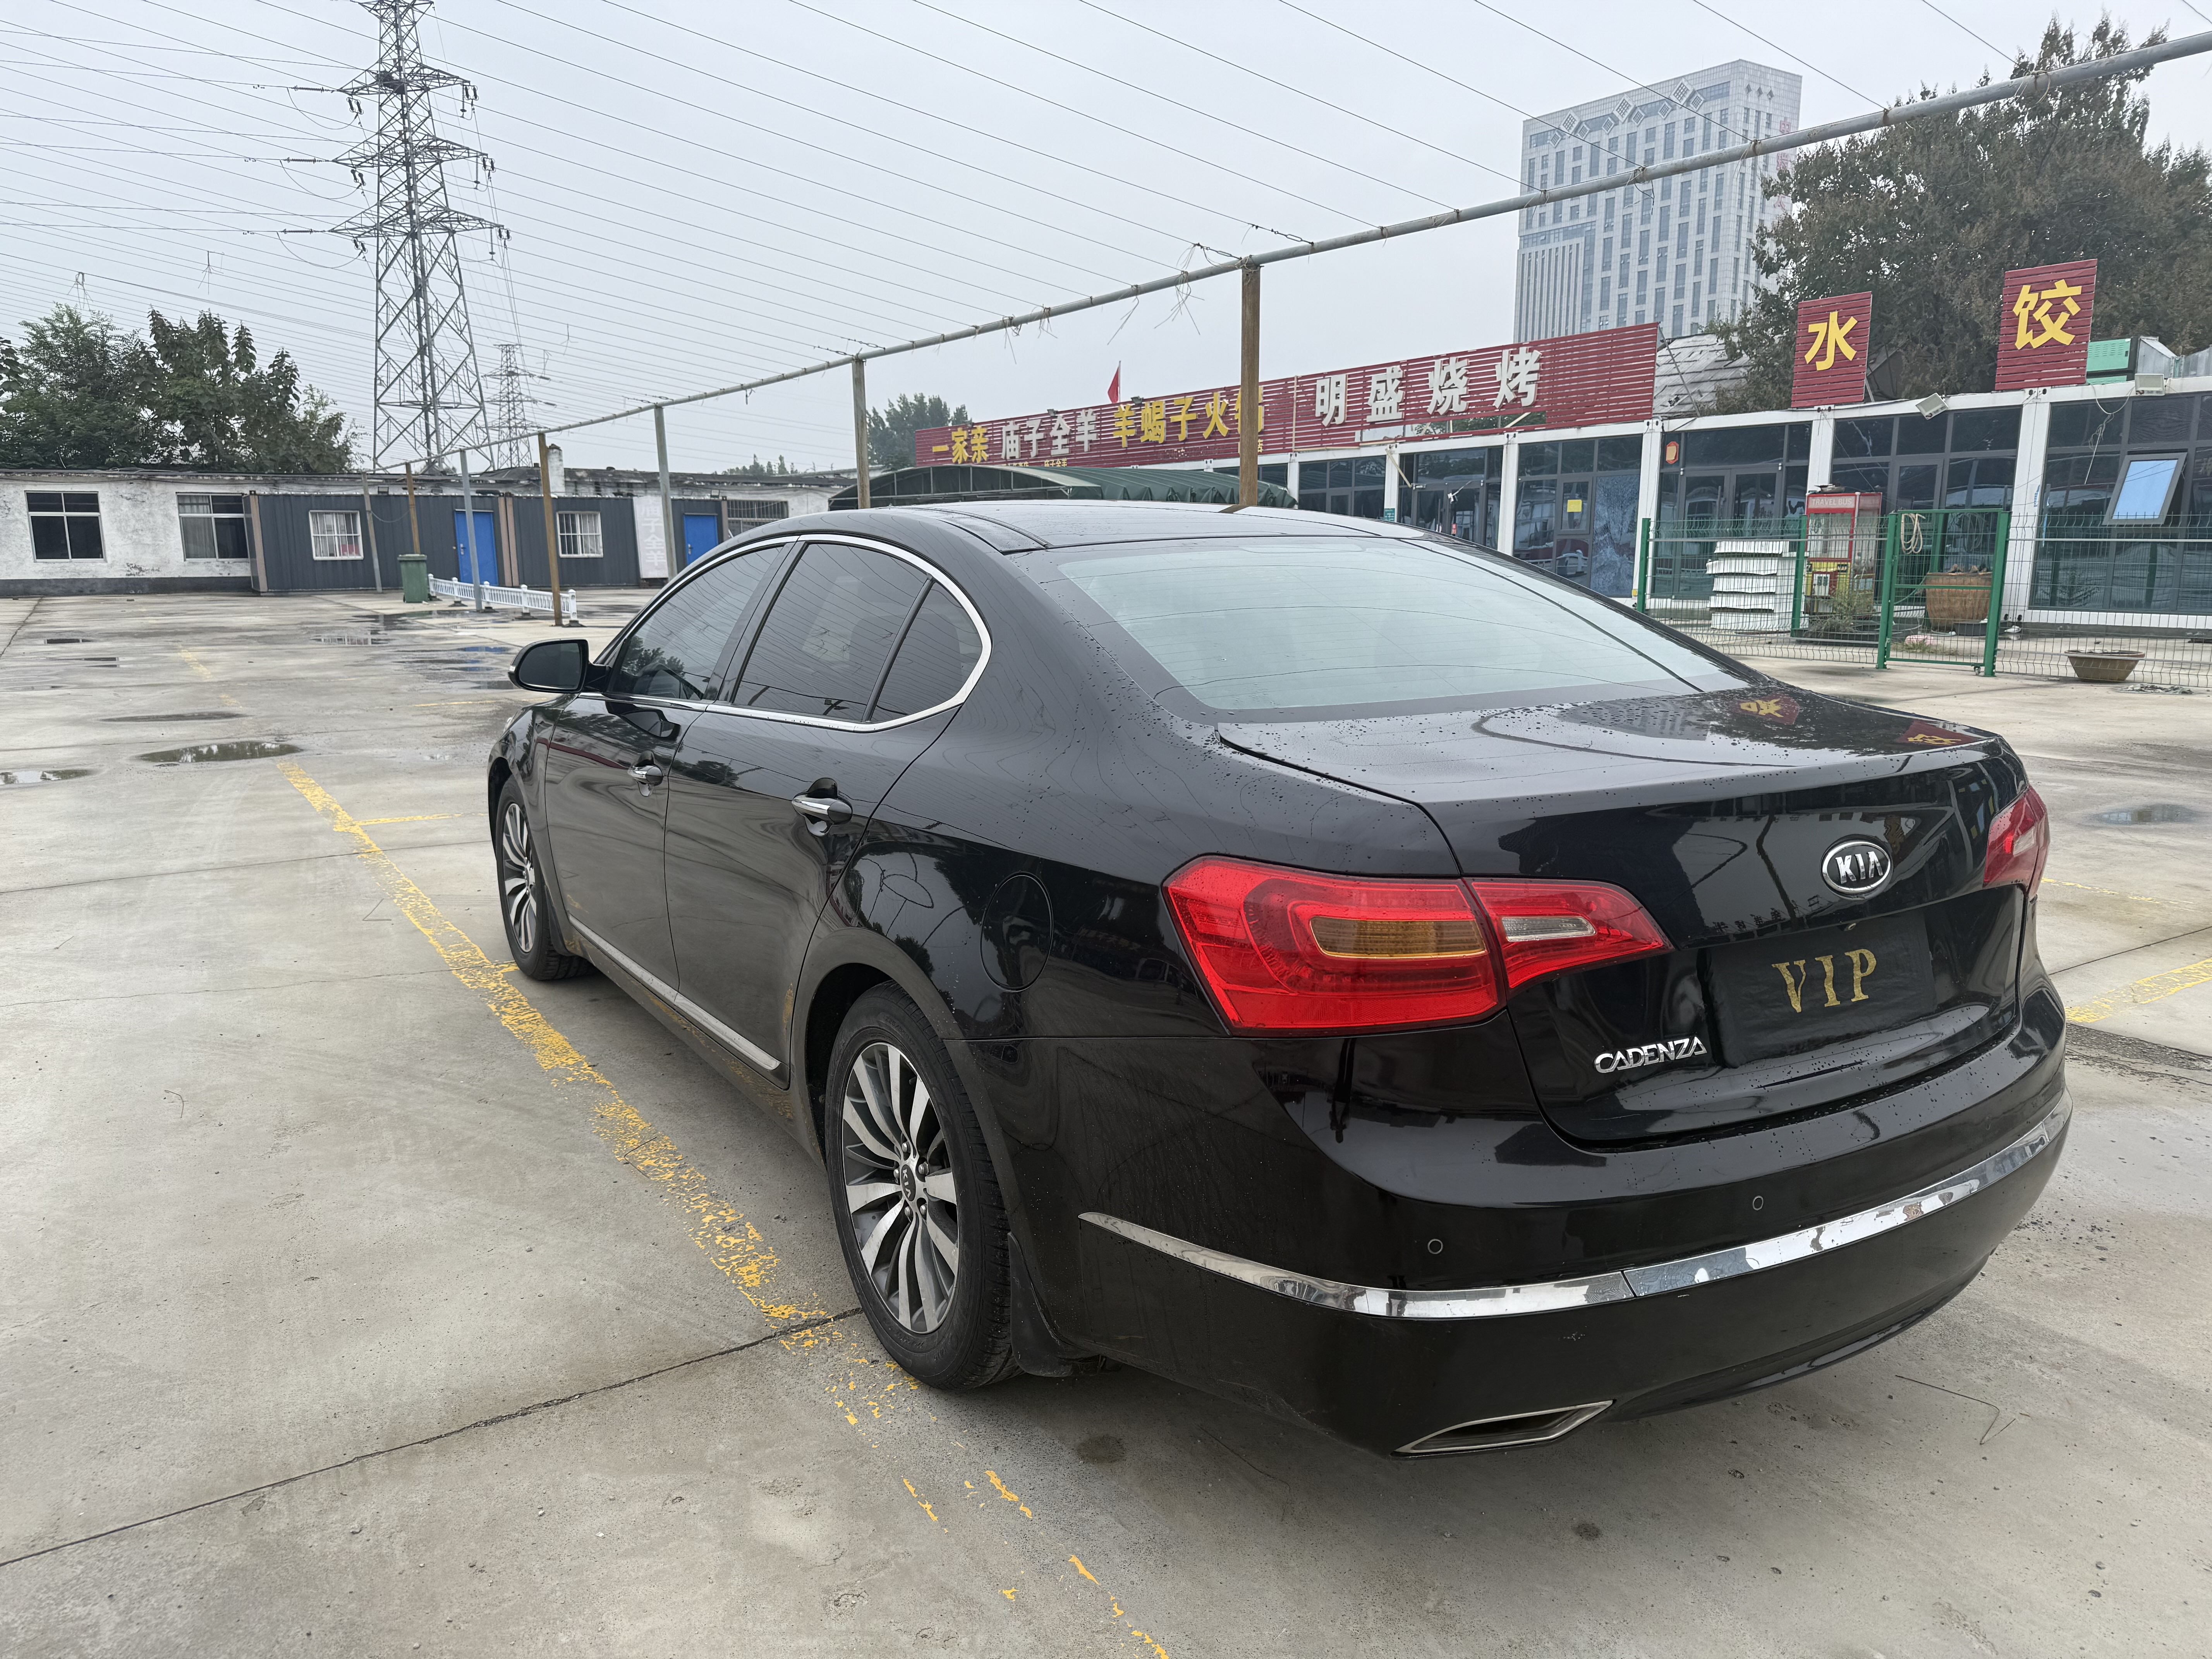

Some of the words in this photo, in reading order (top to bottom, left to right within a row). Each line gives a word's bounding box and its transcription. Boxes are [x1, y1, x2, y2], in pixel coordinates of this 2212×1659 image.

[1805, 311, 1858, 371] 水
[2013, 279, 2082, 350] 饺
[1315, 347, 1542, 427] 明盛烧烤
[932, 426, 989, 464] 一家亲
[1001, 409, 1099, 459] 庙子全羊
[1835, 851, 1883, 884] KIA
[1771, 949, 1877, 1013] VIP
[1595, 1036, 1707, 1073] CADENZA
[903, 1169, 911, 1198] KIA
